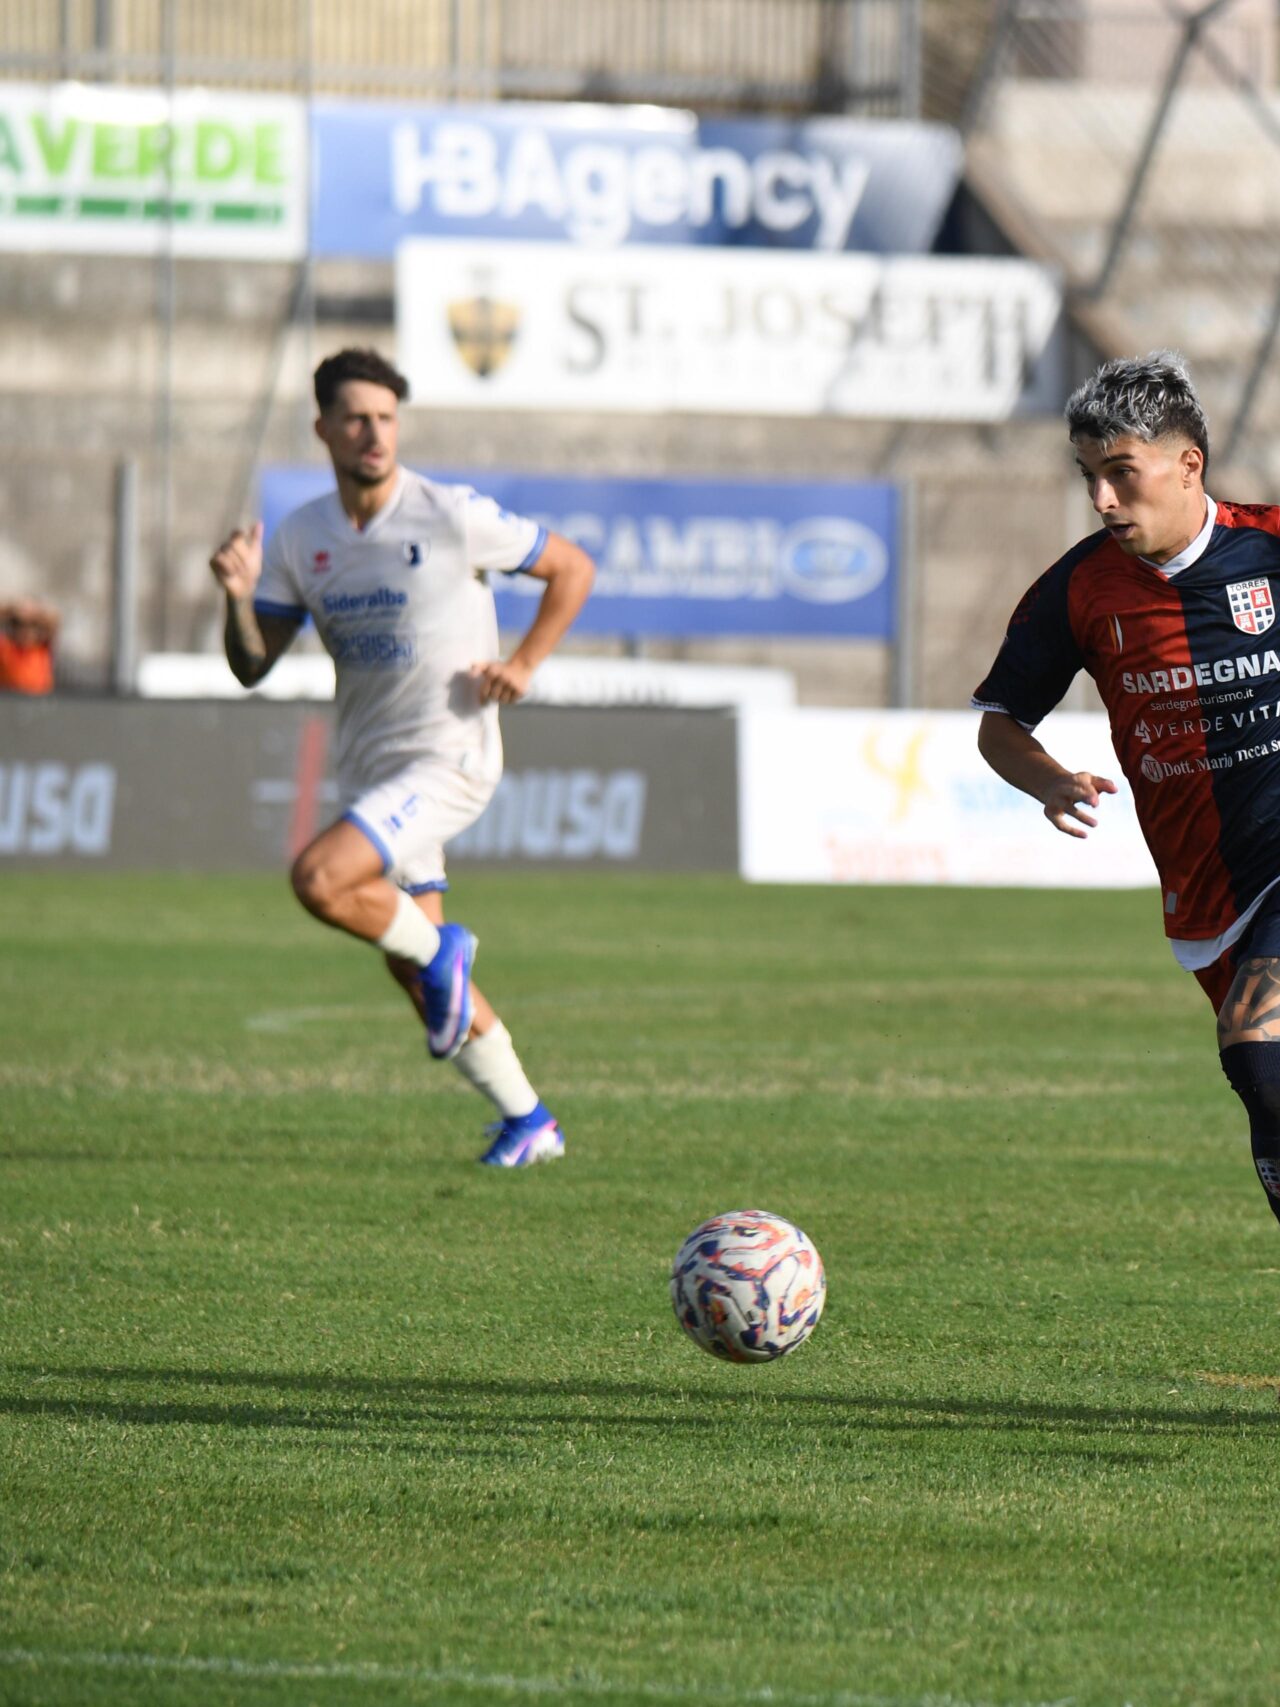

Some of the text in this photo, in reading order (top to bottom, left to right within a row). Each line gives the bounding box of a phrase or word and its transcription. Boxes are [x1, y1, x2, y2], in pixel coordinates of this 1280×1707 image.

[1230, 578, 1266, 592] TORRES
[1150, 687, 1254, 712] sardegnaturismo.it
[1152, 716, 1225, 739] VERDE
[1163, 760, 1195, 777] Dott.
